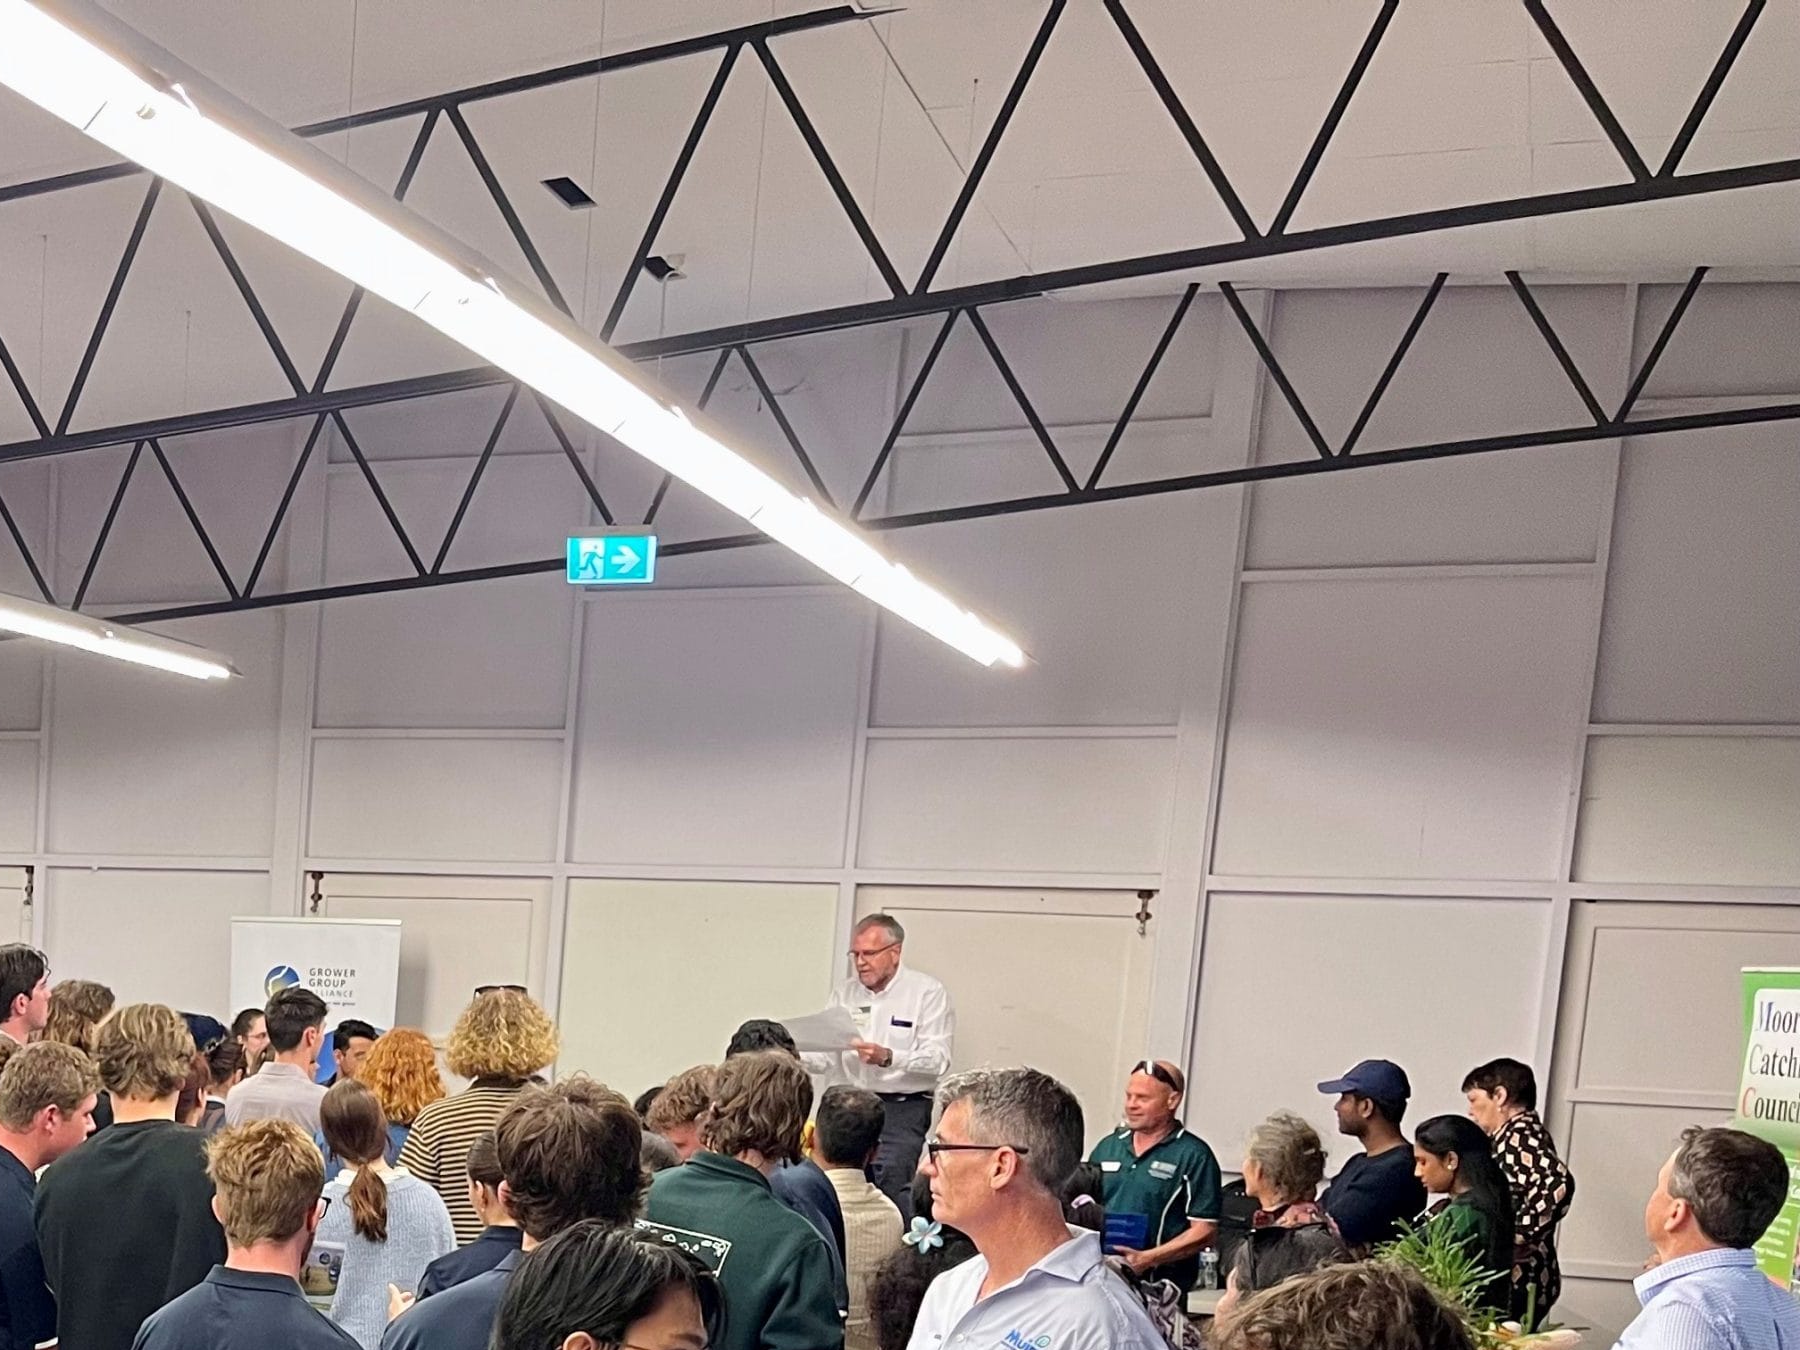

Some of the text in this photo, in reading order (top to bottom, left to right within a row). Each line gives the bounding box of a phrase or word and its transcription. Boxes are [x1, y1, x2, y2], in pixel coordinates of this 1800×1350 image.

[308, 978, 346, 988] GROUP
[309, 968, 356, 977] GROWER
[1755, 1001, 1800, 1034] Moor
[1749, 1043, 1800, 1079] Catch
